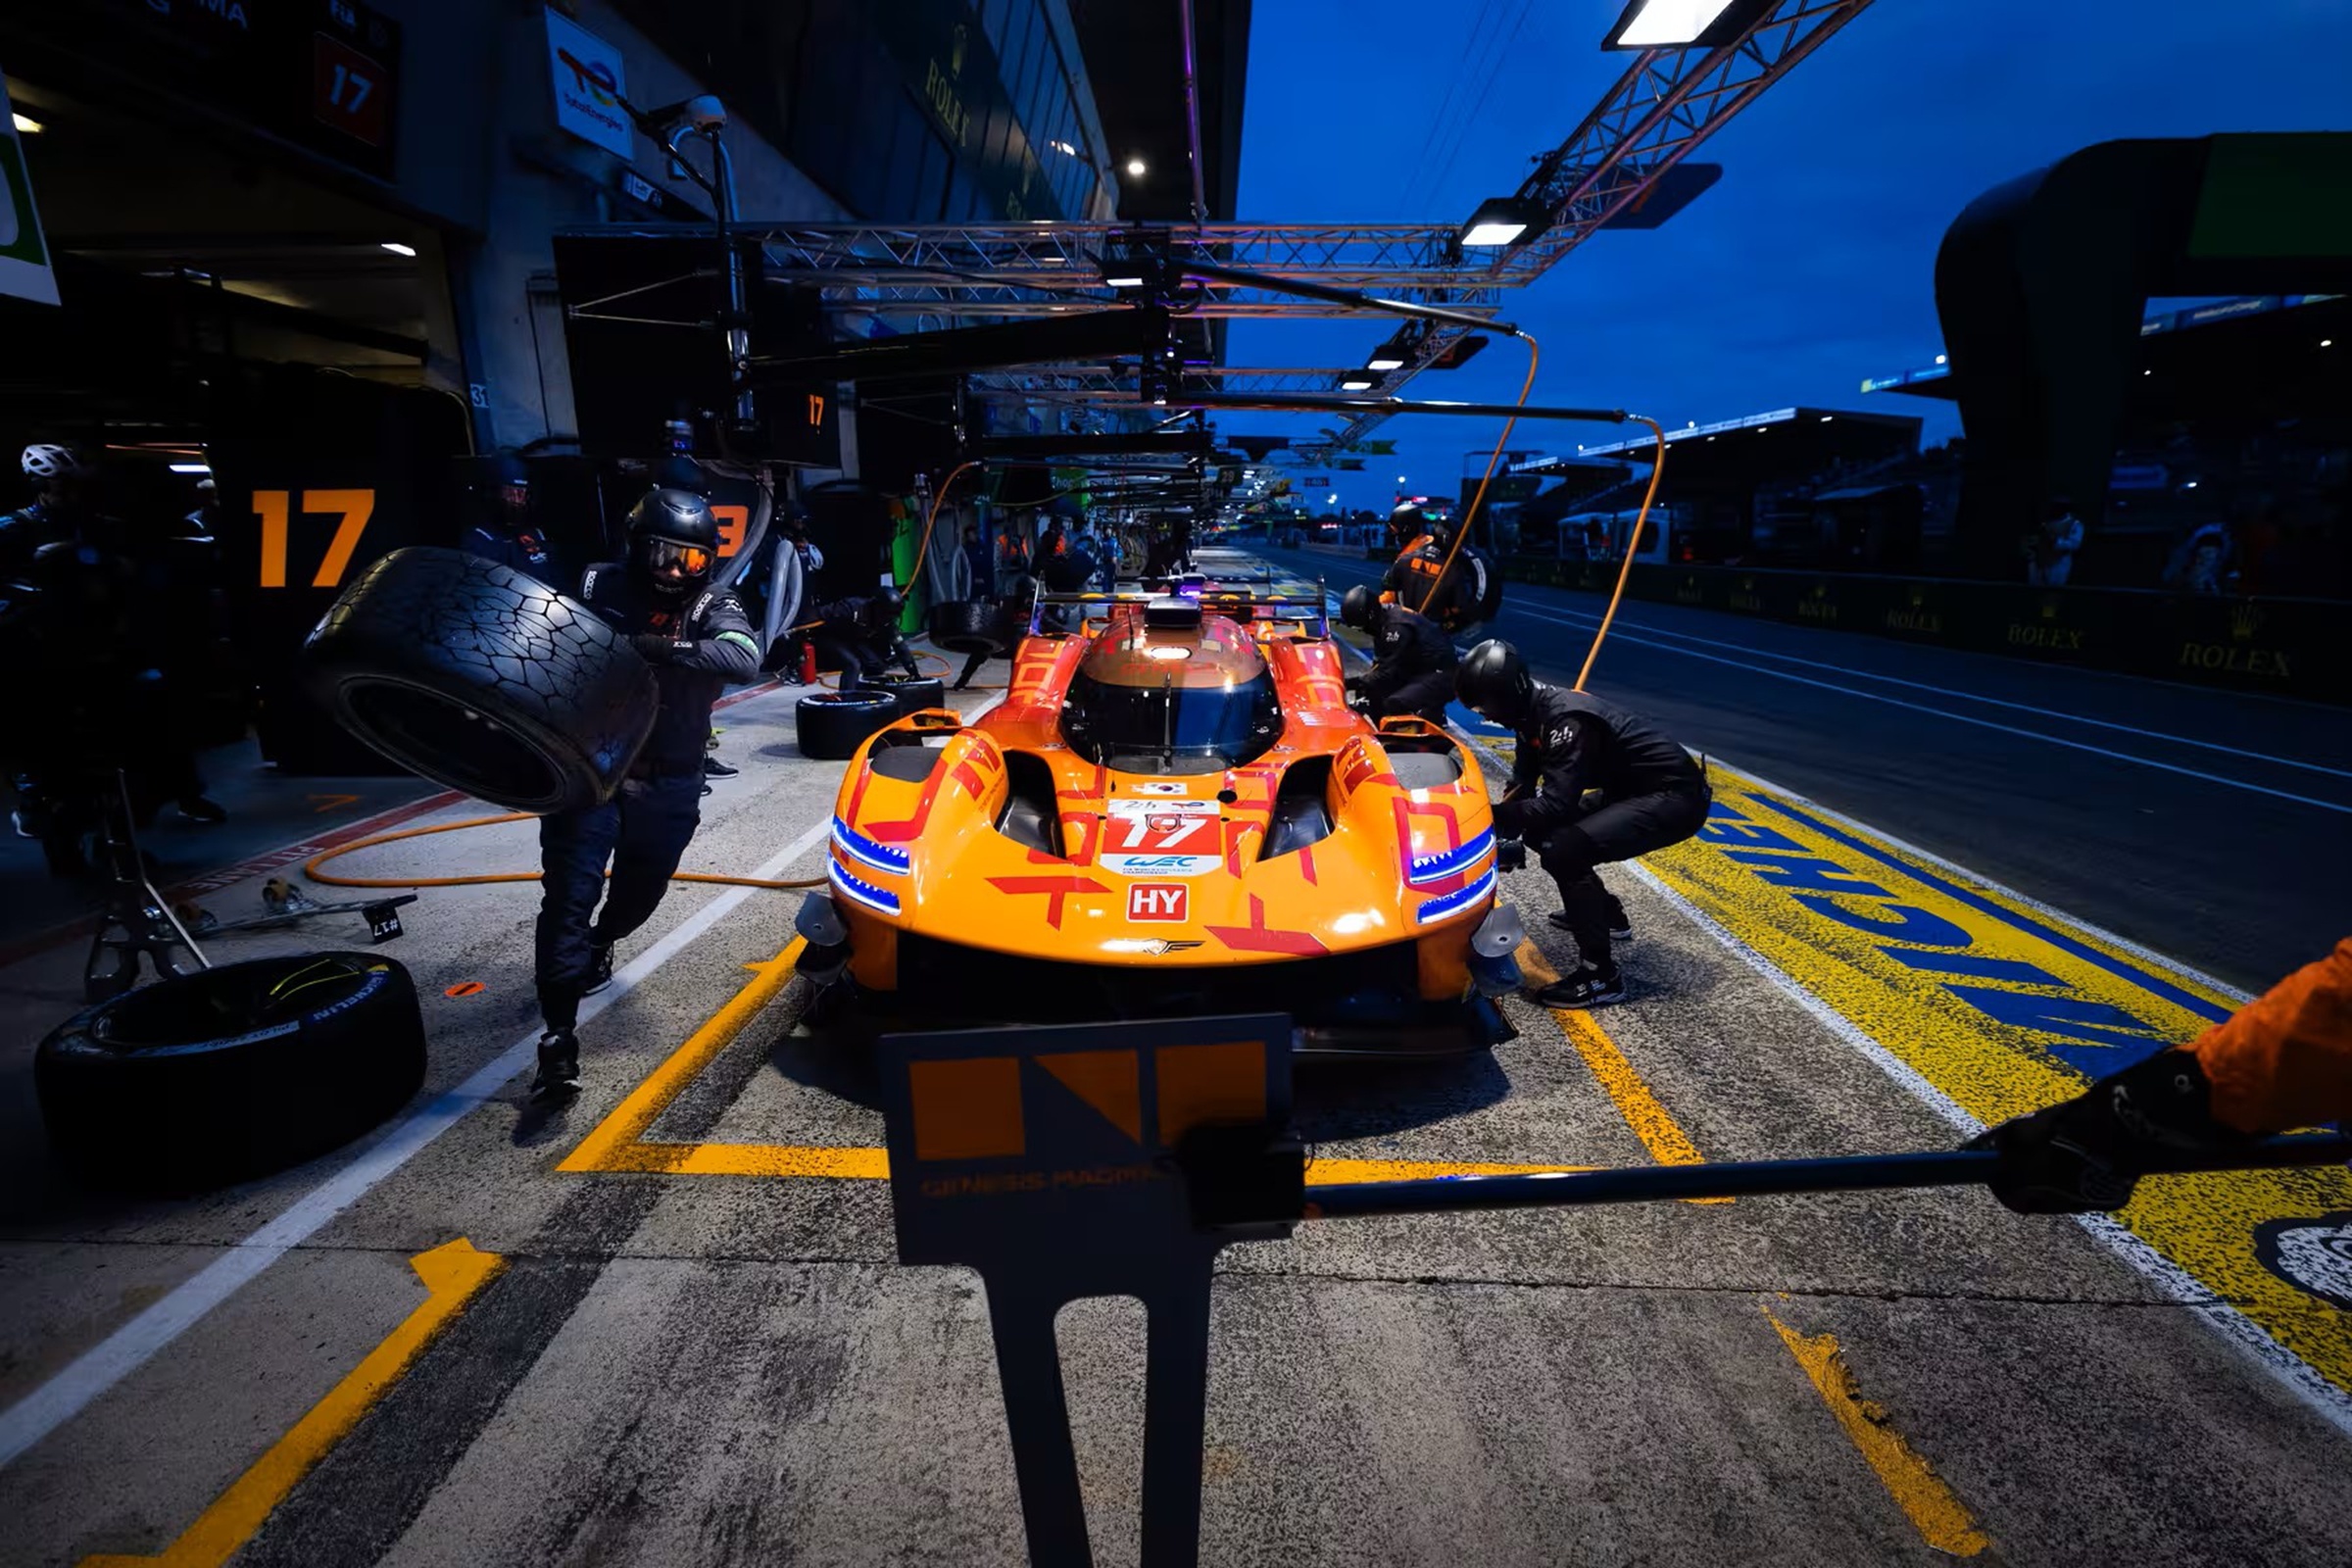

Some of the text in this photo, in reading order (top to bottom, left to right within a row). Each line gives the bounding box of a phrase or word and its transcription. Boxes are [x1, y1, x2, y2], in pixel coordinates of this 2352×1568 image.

[330, 64, 374, 115] 17
[925, 56, 970, 147] ROLEX
[808, 394, 824, 427] 17
[253, 489, 374, 588] 17
[2007, 621, 2084, 651] ROLEX
[2178, 640, 2293, 677] ROLEX
[1120, 813, 1208, 849] 17
[1123, 856, 1198, 867] WEC
[1132, 889, 1184, 914] HY
[373, 917, 400, 938] #17
[1694, 799, 2171, 1084] MICHE
